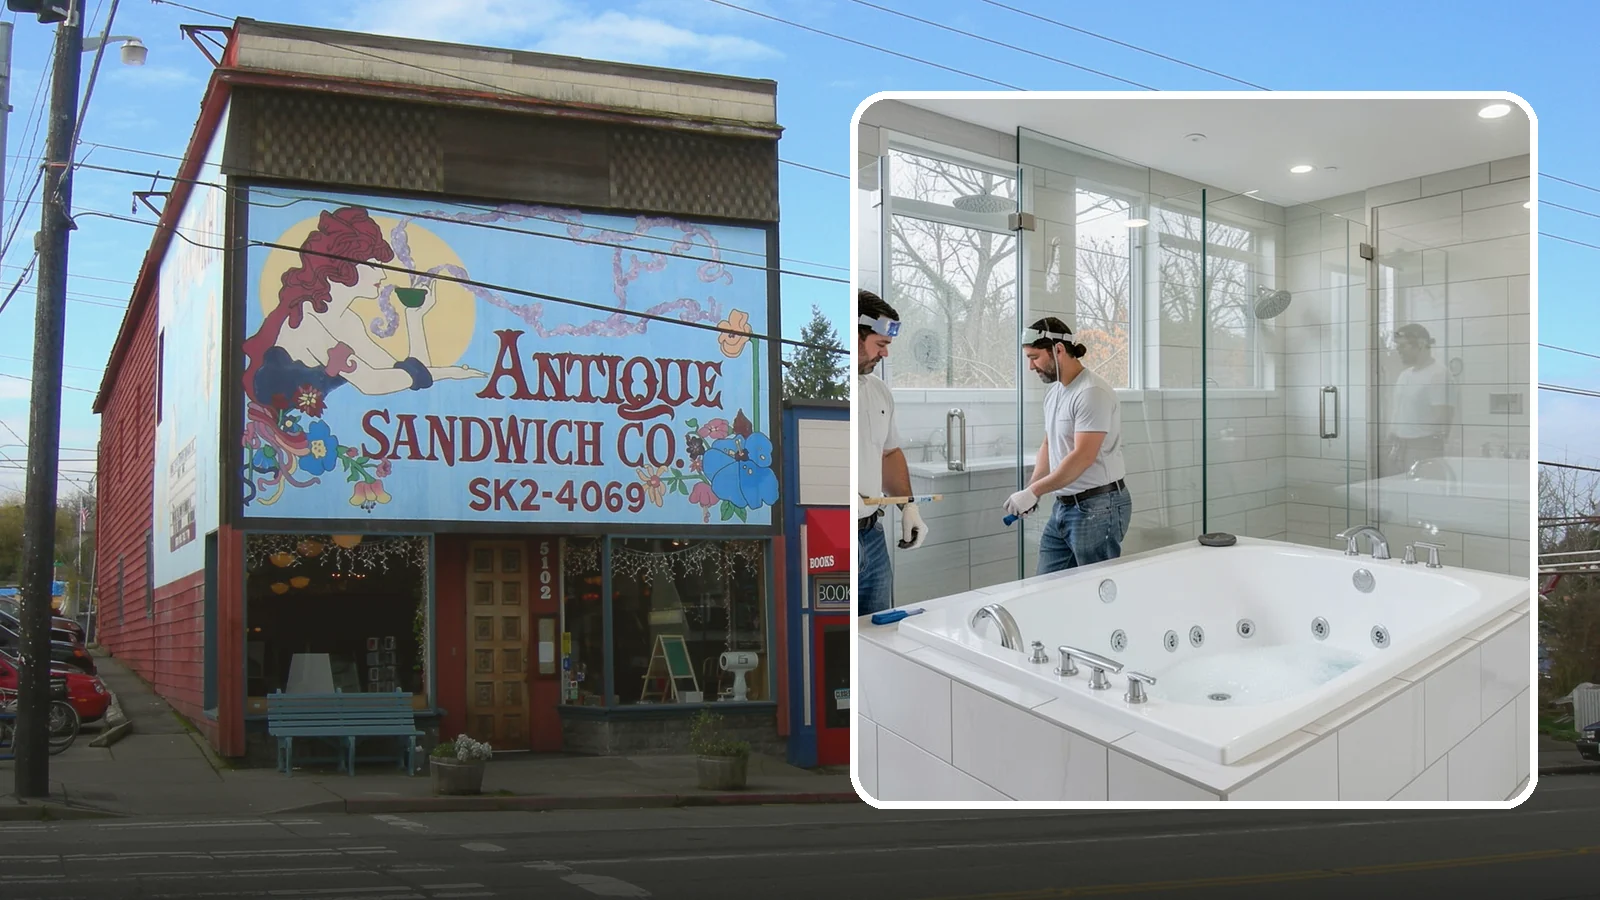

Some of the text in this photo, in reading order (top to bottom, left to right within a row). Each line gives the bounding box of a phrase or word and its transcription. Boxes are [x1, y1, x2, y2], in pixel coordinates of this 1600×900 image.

[475, 329, 724, 420] ANTIQUE
[361, 408, 684, 469] SANDWICH CO.
[468, 477, 646, 513] SK2-4069
[540, 541, 551, 600] 5102
[809, 555, 835, 569] BOOKS
